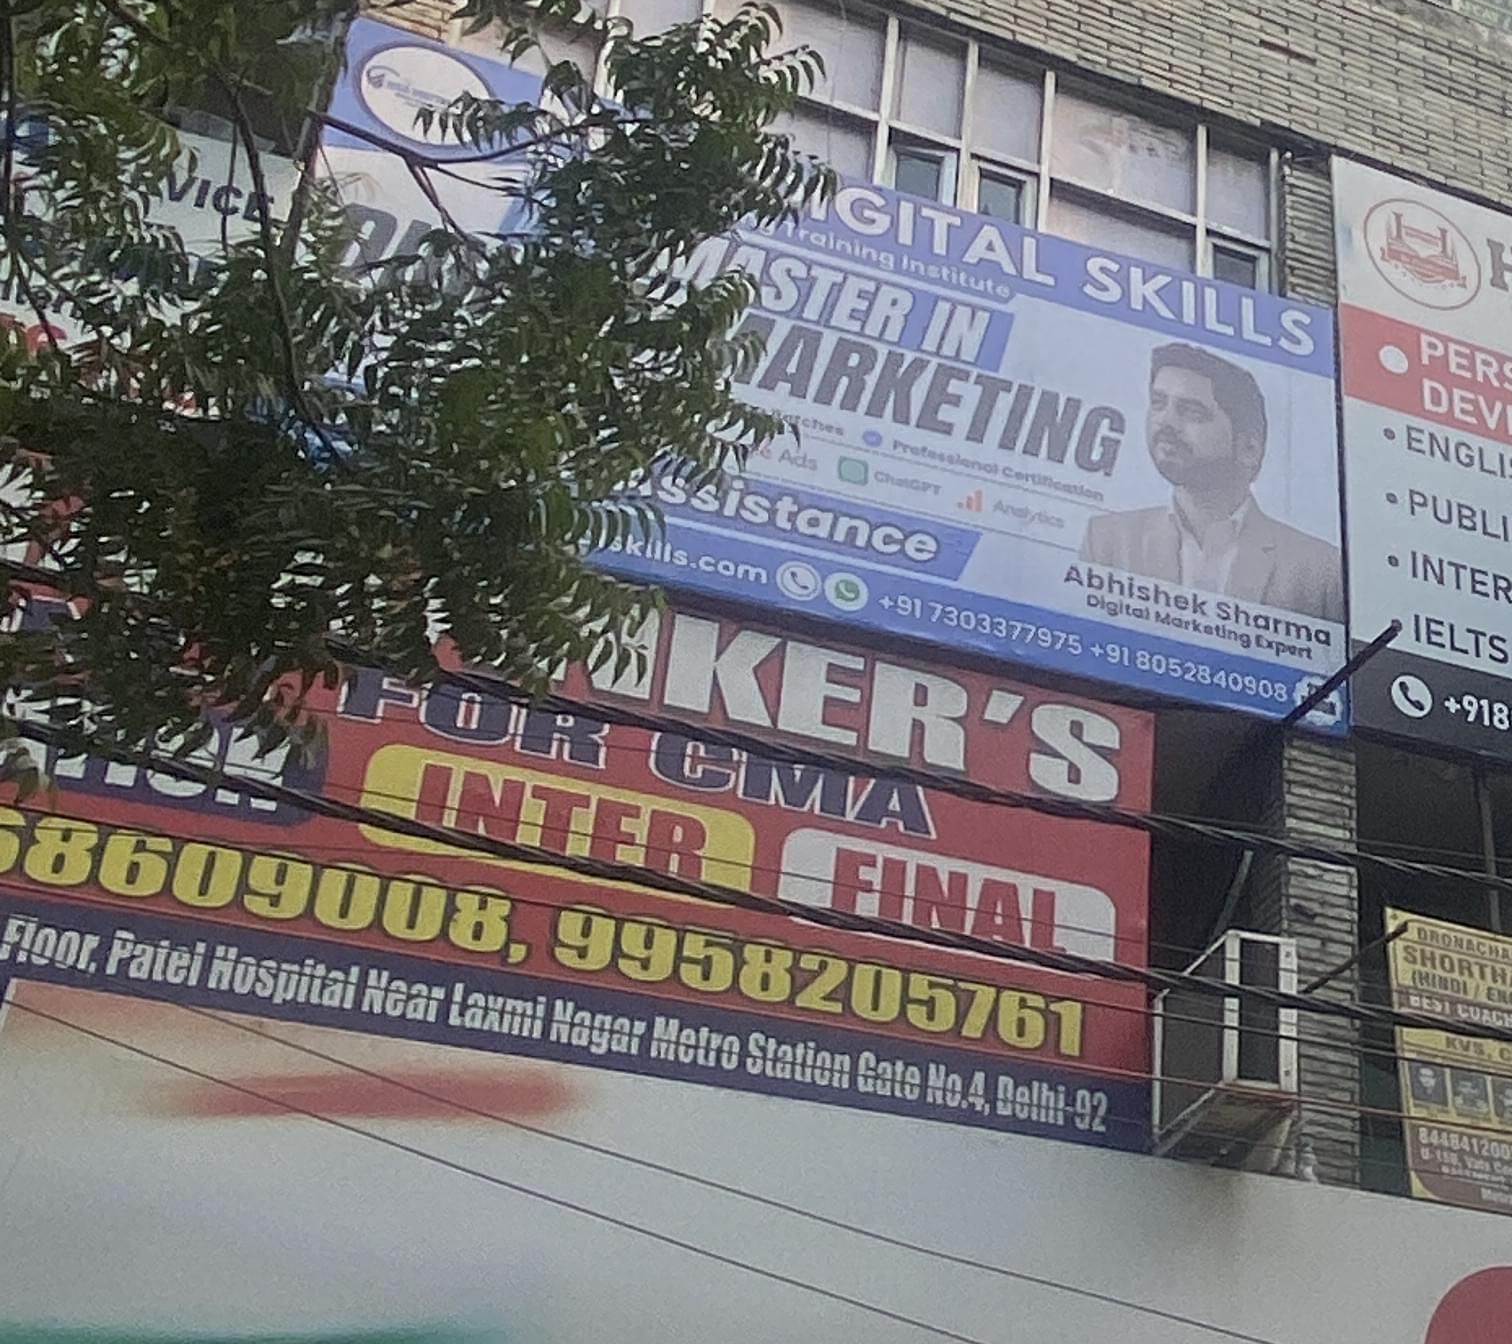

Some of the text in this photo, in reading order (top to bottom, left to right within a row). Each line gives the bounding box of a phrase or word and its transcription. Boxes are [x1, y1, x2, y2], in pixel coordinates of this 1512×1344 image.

[785, 222, 1012, 299] Training Institute
[1083, 255, 1317, 357] SKILLS
[920, 299, 991, 363] IN
[640, 470, 939, 565] ssistance
[1063, 563, 1333, 648] Abhishek Sharma
[1086, 593, 1314, 662] Digital Marketing Expert
[1412, 612, 1511, 666] IELTS
[414, 758, 711, 884] INTER
[830, 844, 1070, 956] FINAL
[555, 904, 1087, 1058] 9958205761
[105, 928, 207, 990] Patel
[208, 942, 359, 1016] Hospital
[365, 969, 443, 1026] Near
[447, 982, 548, 1039] Laxmi
[550, 998, 647, 1058] Nagar
[650, 1017, 740, 1071] Metro
[744, 1030, 853, 1088] Station
[856, 1050, 923, 1098] Gate
[995, 1076, 1110, 1135] Delhi-92
